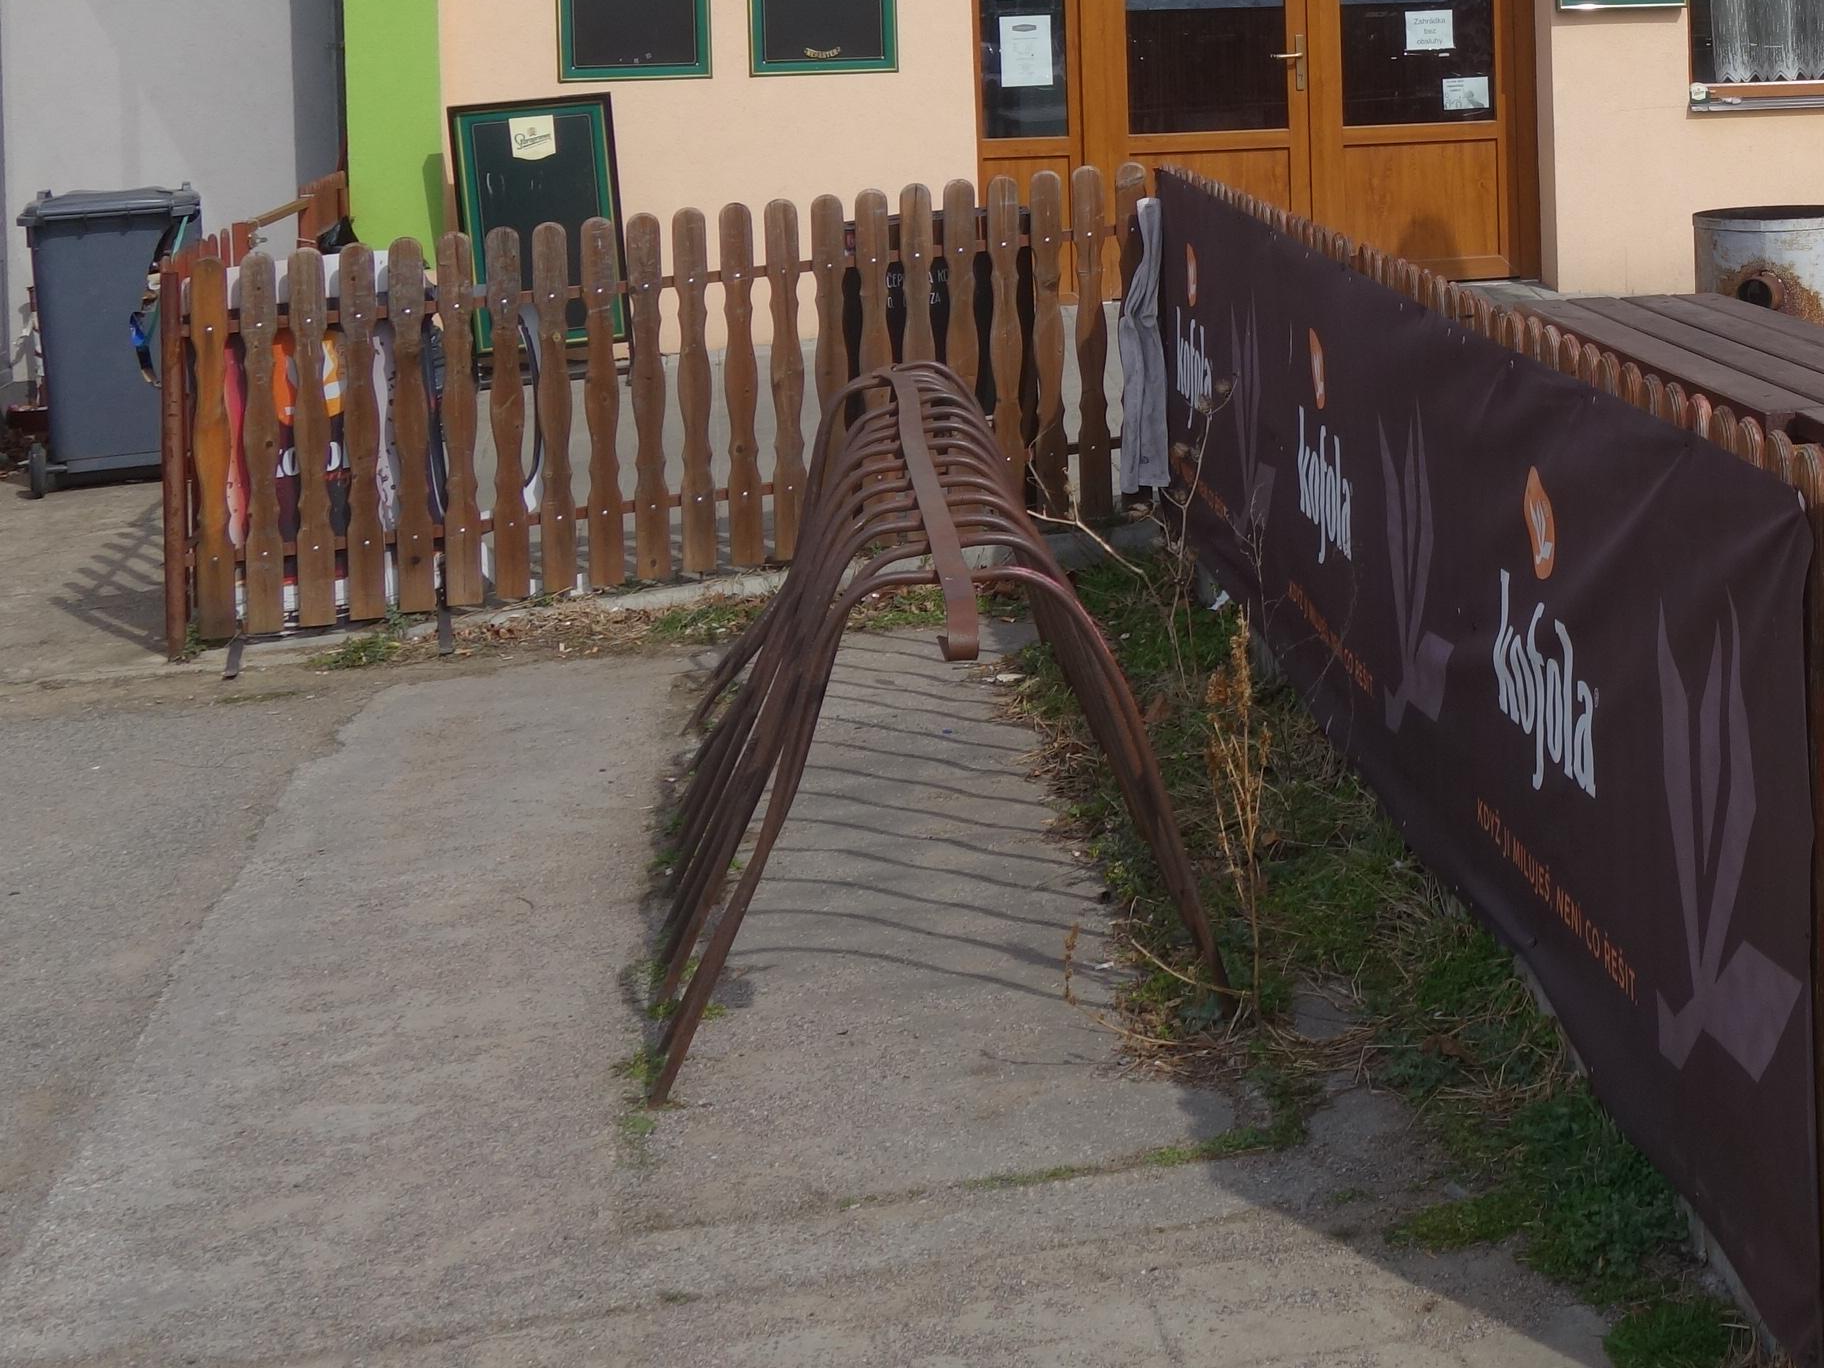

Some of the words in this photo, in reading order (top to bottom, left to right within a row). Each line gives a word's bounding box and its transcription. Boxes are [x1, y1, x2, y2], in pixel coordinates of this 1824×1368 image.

[1298, 405, 1352, 565] kofola
[1492, 568, 1596, 800] kofola
[1477, 796, 1501, 846] KDYŽ
[1502, 826, 1510, 858] JI
[1556, 885, 1582, 938] NENÍ
[1585, 919, 1600, 958] CO
